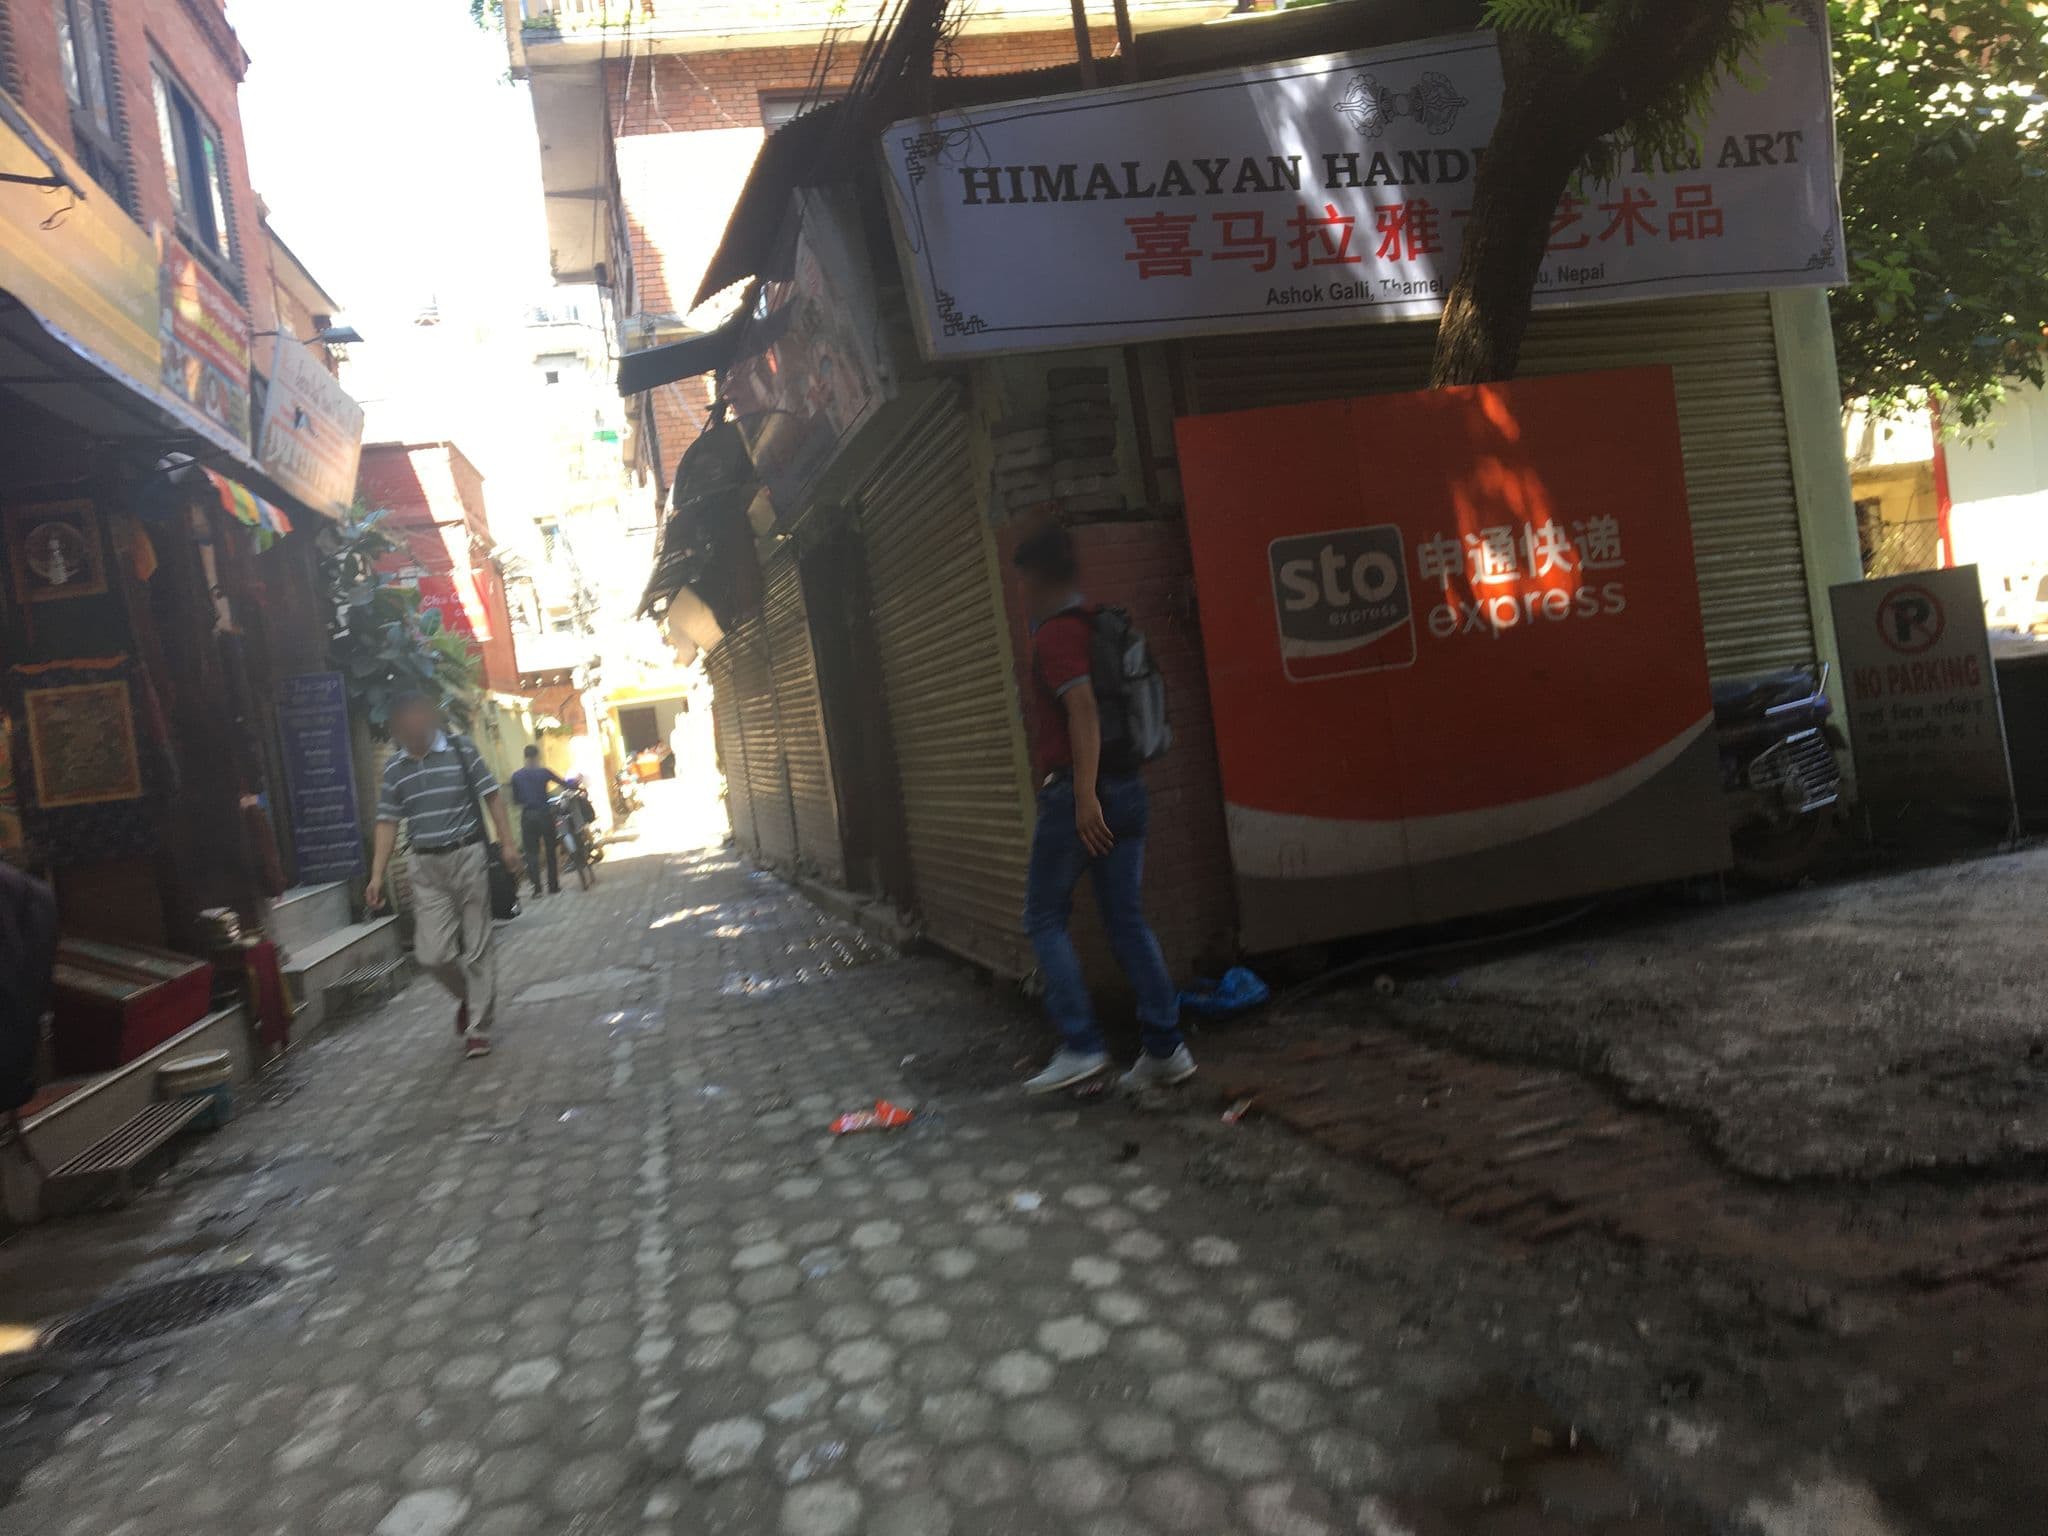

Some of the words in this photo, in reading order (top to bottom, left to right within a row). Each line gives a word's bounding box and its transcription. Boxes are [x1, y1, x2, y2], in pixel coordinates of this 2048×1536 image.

[959, 155, 1302, 206] HIMALAYAN
[1716, 131, 1803, 169] ART
[1266, 283, 1329, 305] Ashok
[1330, 280, 1375, 302] Galli,
[1557, 263, 1605, 284] Nepal
[1279, 544, 1399, 612] sto
[1417, 514, 1627, 590] 申通快递
[1428, 582, 1628, 640] express
[1854, 666, 1883, 698] NO
[1886, 655, 1981, 697] PARKING
